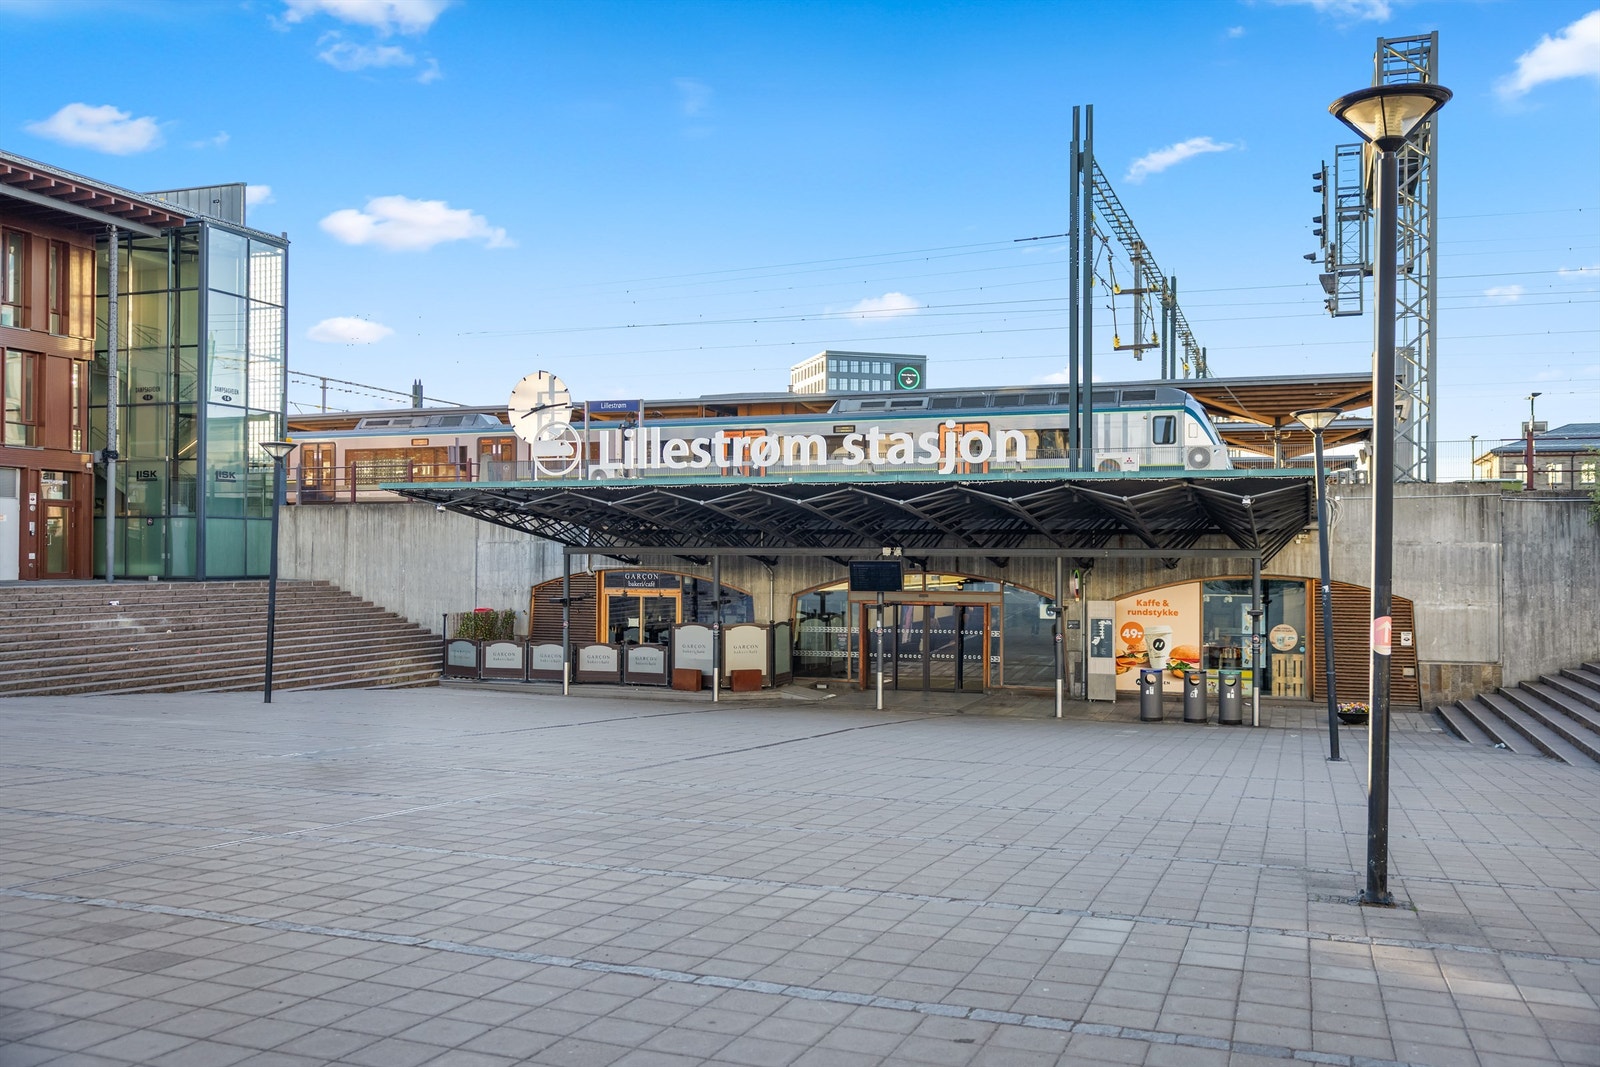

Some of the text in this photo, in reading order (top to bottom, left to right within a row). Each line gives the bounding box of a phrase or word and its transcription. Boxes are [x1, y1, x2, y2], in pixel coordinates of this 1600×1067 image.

[600, 419, 1027, 475] Lillestrøm stasjon
[1136, 599, 1161, 607] Kaffe
[1127, 608, 1179, 618] rundstykke
